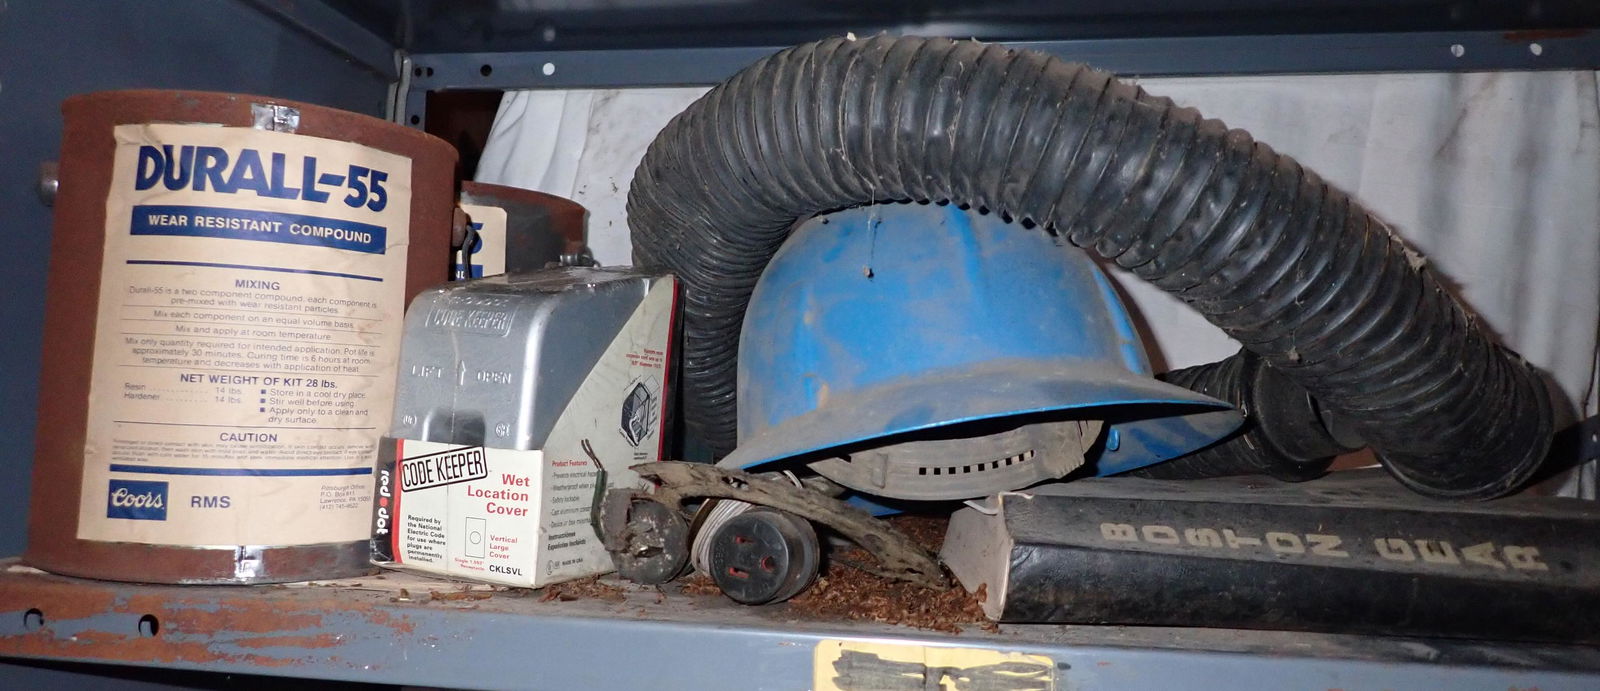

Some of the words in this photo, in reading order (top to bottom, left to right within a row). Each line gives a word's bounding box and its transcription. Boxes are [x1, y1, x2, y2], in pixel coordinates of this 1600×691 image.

[135, 145, 389, 212] DURALL-55
[149, 214, 188, 227] WEAR
[195, 216, 282, 233] RESISTANT
[289, 223, 372, 244] COMPOUND
[235, 279, 281, 290] MIXING
[199, 289, 252, 299] component
[307, 296, 327, 304] each
[329, 298, 370, 309] component
[217, 298, 236, 307] with
[264, 302, 302, 311] resistant
[193, 311, 245, 321] component
[276, 316, 300, 326] equal
[303, 318, 332, 327] volume
[434, 309, 463, 326] CODE
[464, 310, 508, 329] KEEPER
[193, 326, 210, 334] and
[213, 328, 238, 337] apply
[240, 328, 250, 336] at
[140, 338, 157, 347] only
[160, 339, 194, 348] quantity
[197, 340, 235, 350] required
[238, 341, 250, 349] for
[253, 343, 292, 352] intended
[344, 347, 357, 355] Pot
[358, 348, 368, 356] life
[132, 348, 189, 357] approximately
[192, 348, 202, 356] 30
[247, 351, 278, 361] Curing
[280, 353, 299, 361] time
[318, 355, 340, 363] hours
[342, 356, 350, 364] at
[142, 357, 191, 366] temperature
[194, 358, 211, 366] and
[214, 359, 260, 368] decreases
[263, 361, 281, 369] with
[284, 363, 331, 373] application
[333, 364, 341, 372] of
[180, 373, 204, 383] NET
[209, 374, 259, 385] WEIGHT
[263, 377, 280, 386] OF
[283, 377, 303, 387] KIT
[306, 378, 318, 388] 28
[321, 379, 338, 388] lbs.
[412, 364, 444, 378] LIFT
[477, 371, 512, 385] OPEN
[125, 382, 146, 390] Resin
[123, 392, 160, 401] Hardener
[270, 388, 294, 397] Store
[296, 389, 304, 397] in
[314, 390, 331, 398] cool
[333, 391, 346, 400] dry
[269, 397, 284, 405] Stir
[306, 398, 333, 406] before
[269, 407, 295, 416] Apply
[297, 408, 315, 416] only
[268, 416, 282, 424] dry
[219, 432, 278, 442] CAUTION
[402, 458, 434, 488] CODE
[435, 450, 484, 482] KEEPER
[379, 470, 391, 497] red
[502, 473, 530, 487] Wet
[112, 488, 163, 508] Coors
[467, 485, 529, 501] Location
[191, 495, 231, 508] RMS
[486, 502, 529, 516] Cover
[376, 508, 390, 535] dot
[407, 514, 432, 523] Required
[407, 528, 429, 536] Electric
[418, 523, 442, 531] National
[407, 542, 422, 550] plugs
[490, 535, 518, 544] Vertical
[490, 544, 509, 552] Large
[1100, 521, 1350, 558] BOSTON
[1374, 537, 1550, 572] GEAR
[407, 549, 442, 559] permanently
[489, 552, 510, 560] Cover
[489, 564, 522, 576] CKLSVL
